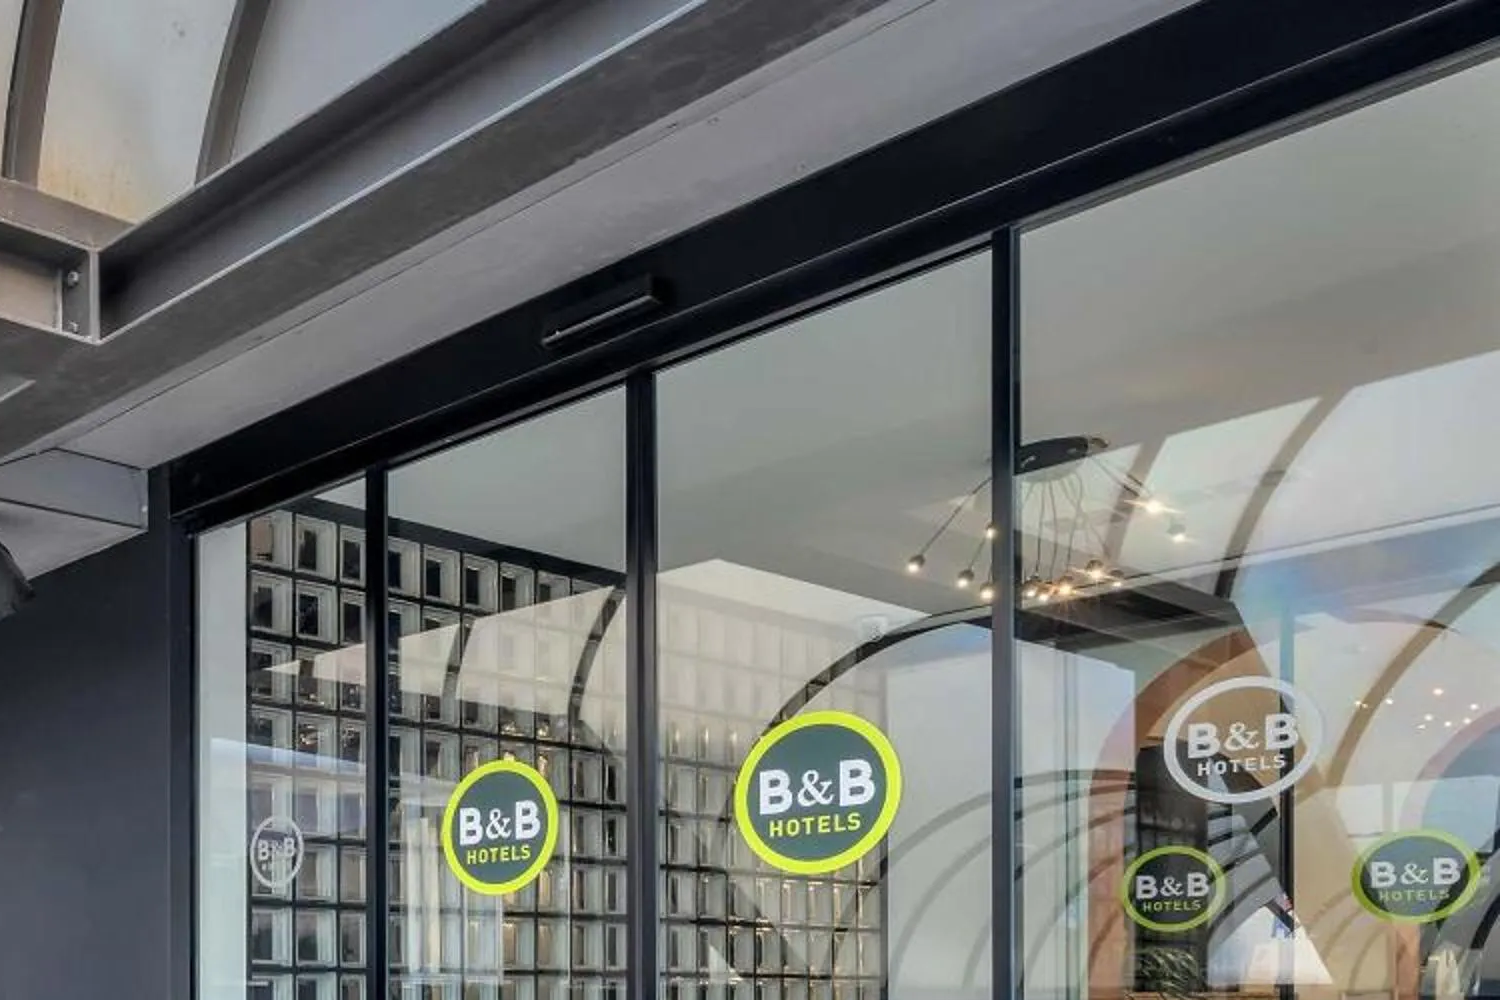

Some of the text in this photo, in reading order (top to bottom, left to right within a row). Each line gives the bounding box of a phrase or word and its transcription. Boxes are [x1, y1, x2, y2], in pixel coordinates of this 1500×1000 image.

[1187, 713, 1299, 758] B&B
[1197, 754, 1286, 777] HOTELS
[758, 758, 876, 815] B&B
[459, 799, 541, 846] B&B
[768, 812, 861, 838] HOTELS
[467, 843, 531, 865] HOTELS
[1136, 872, 1210, 899] B&B
[1369, 857, 1461, 889] B&B
[1142, 900, 1202, 913] HOTELS
[1378, 888, 1450, 901] HOTELS
